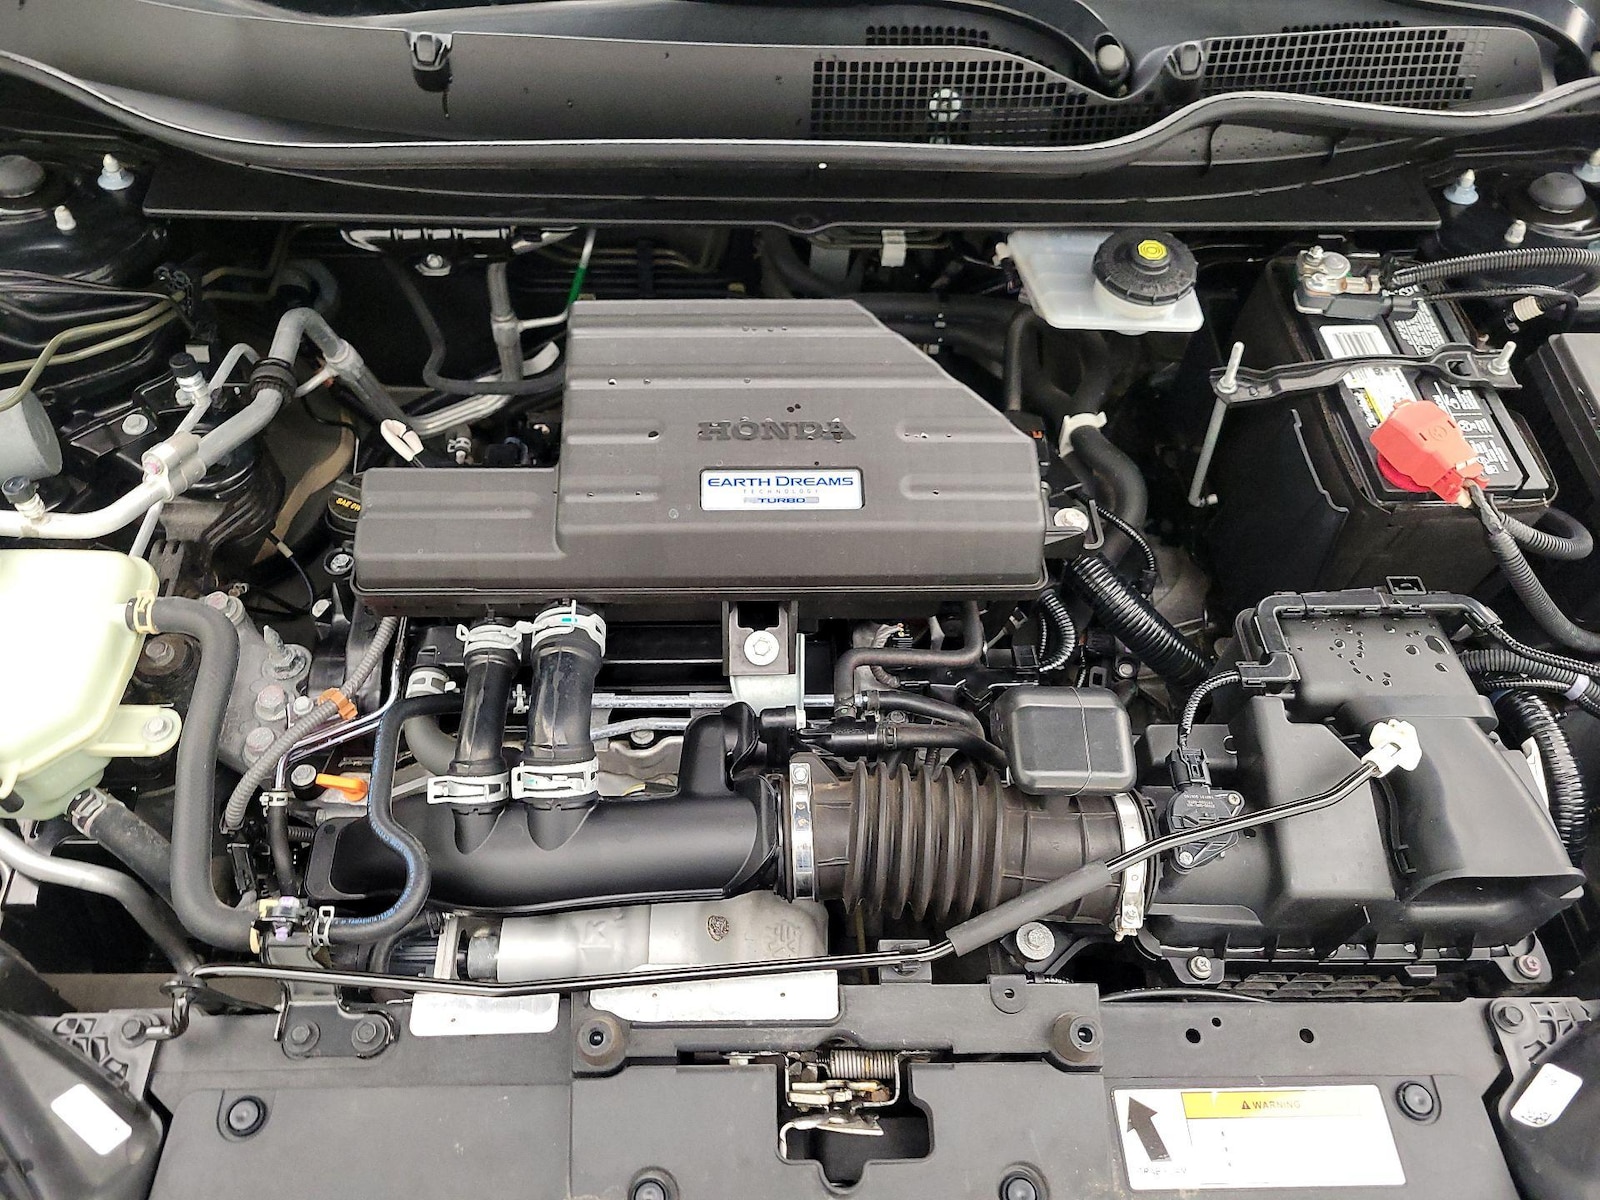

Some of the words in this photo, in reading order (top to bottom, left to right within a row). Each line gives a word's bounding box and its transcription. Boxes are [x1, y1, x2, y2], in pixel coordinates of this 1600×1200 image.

[697, 420, 857, 441] HONDA
[708, 477, 771, 487] EARTH
[775, 476, 853, 487] DREAMS
[1252, 1100, 1301, 1109] WARNING
